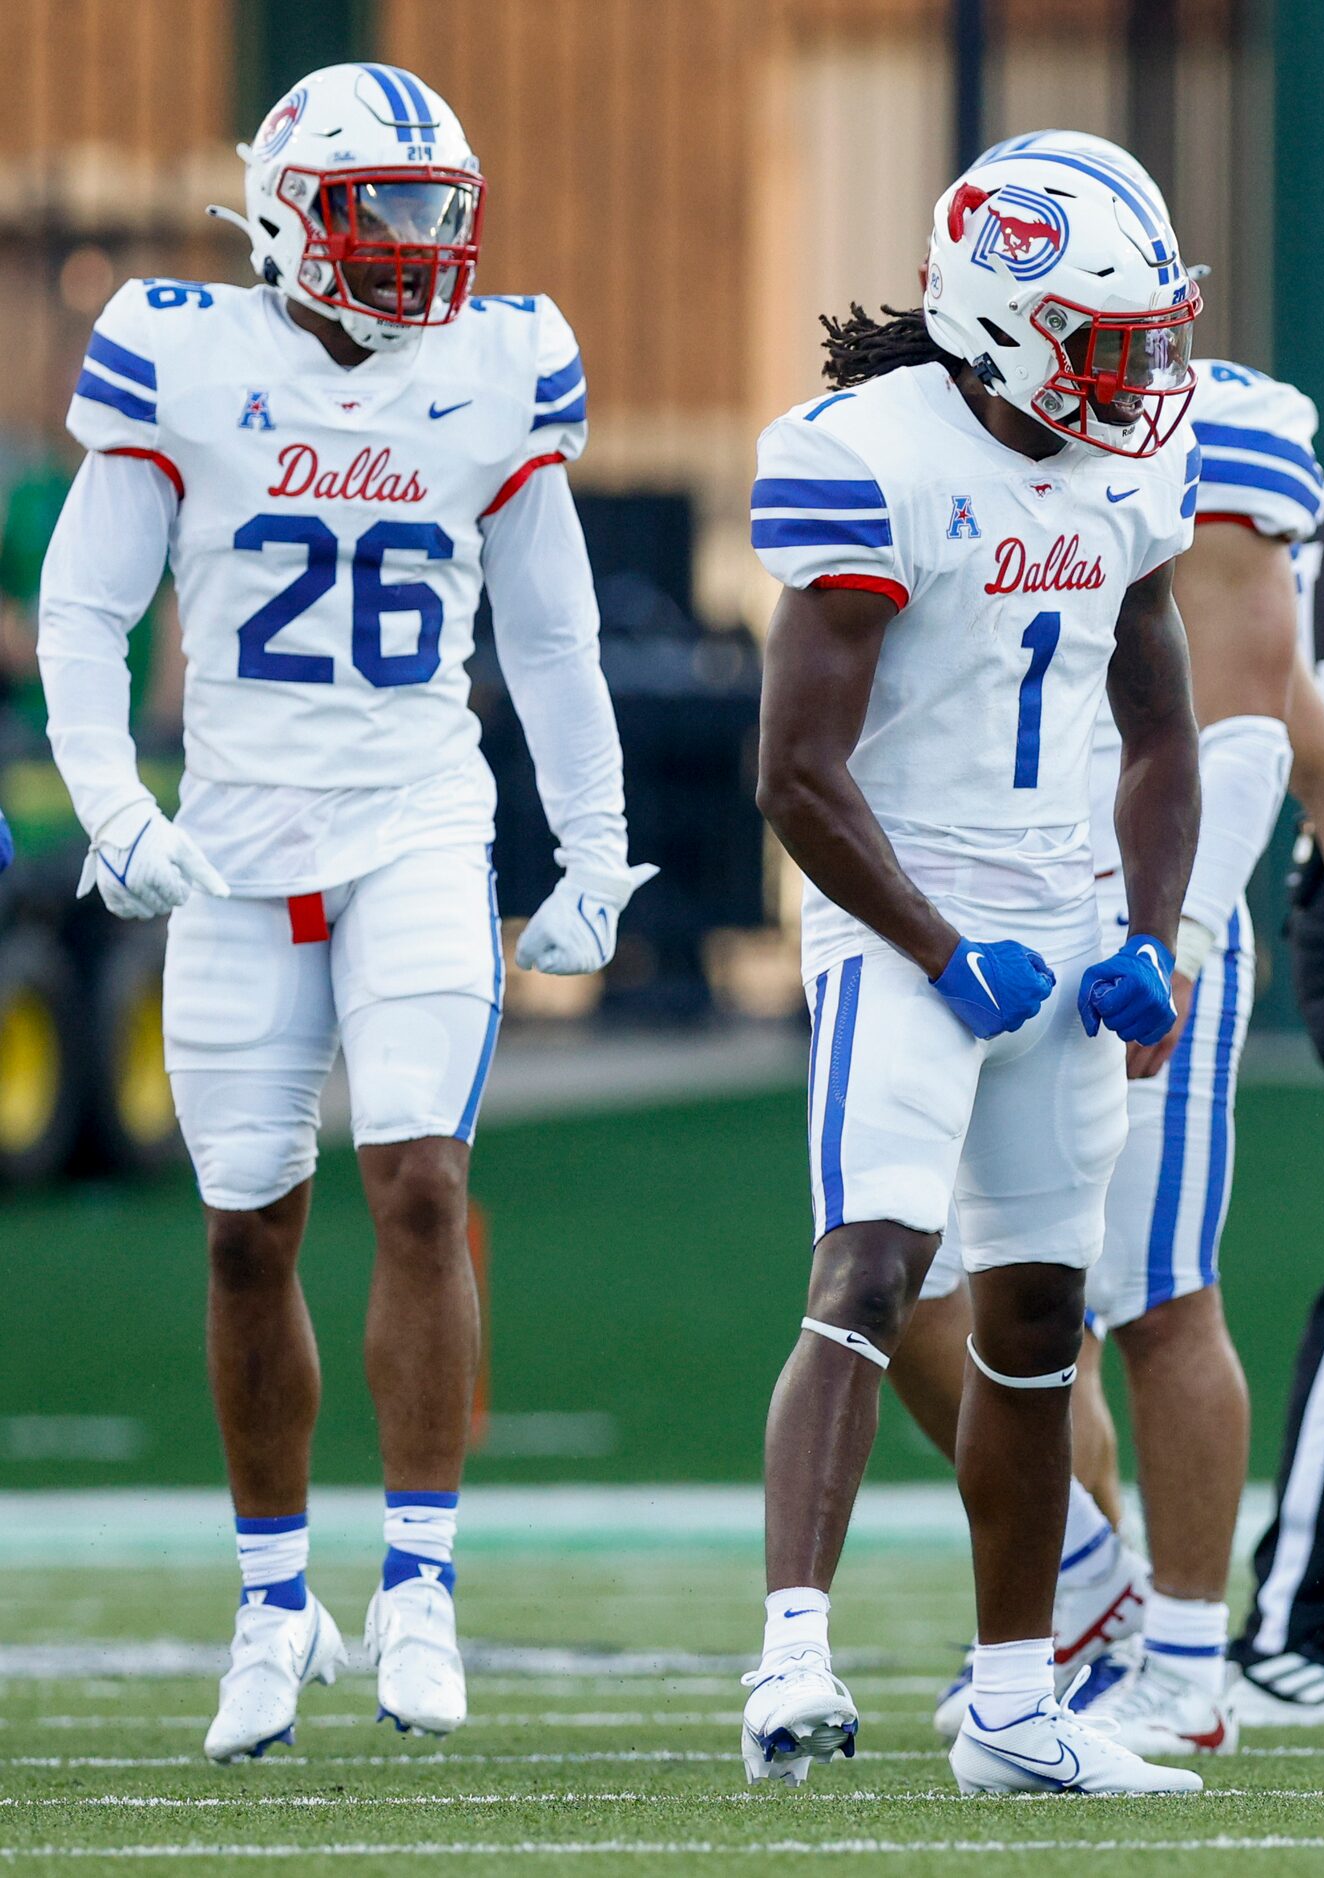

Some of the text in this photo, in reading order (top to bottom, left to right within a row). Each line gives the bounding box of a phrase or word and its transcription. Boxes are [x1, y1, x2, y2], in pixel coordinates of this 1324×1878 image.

[407, 146, 433, 161] 214
[267, 443, 428, 503] Dallas
[984, 533, 1106, 595] Dallas
[233, 513, 454, 689] 26
[1013, 611, 1061, 789] 1
